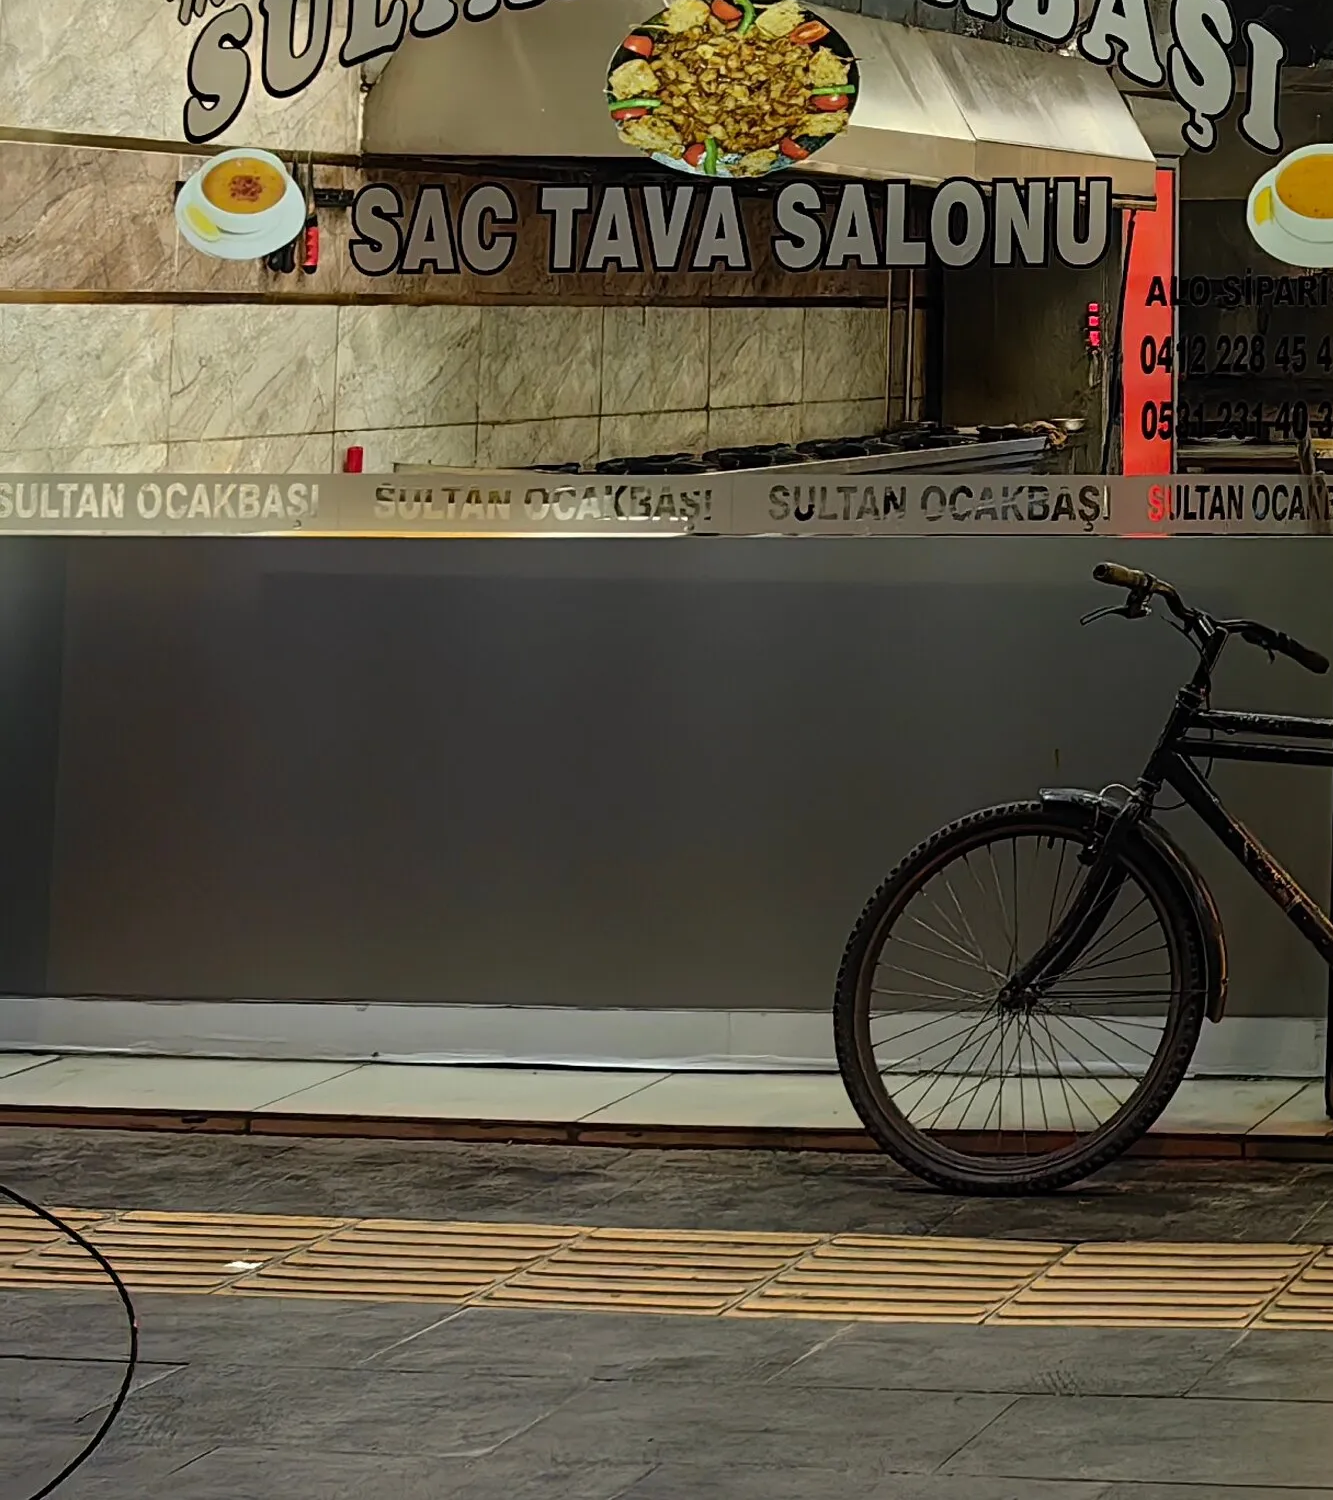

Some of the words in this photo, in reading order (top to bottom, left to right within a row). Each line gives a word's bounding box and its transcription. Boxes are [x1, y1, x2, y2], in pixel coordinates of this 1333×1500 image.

[349, 182, 518, 276] SAC
[535, 182, 752, 274] TAVA
[771, 175, 1113, 271] SALONU
[1145, 275, 1213, 307] ALO
[1140, 334, 1207, 374] 0412
[1216, 334, 1265, 374] 228
[1275, 334, 1307, 374] 45
[1275, 400, 1309, 441] 40
[137, 483, 319, 529] OCAKBAŞI
[374, 483, 511, 520] SULTAN
[524, 484, 712, 532] OCAKBAŞI
[768, 485, 907, 522] SULTAN
[920, 485, 1111, 532] OCAKBAŞI
[1147, 484, 1244, 523] SULTAN
